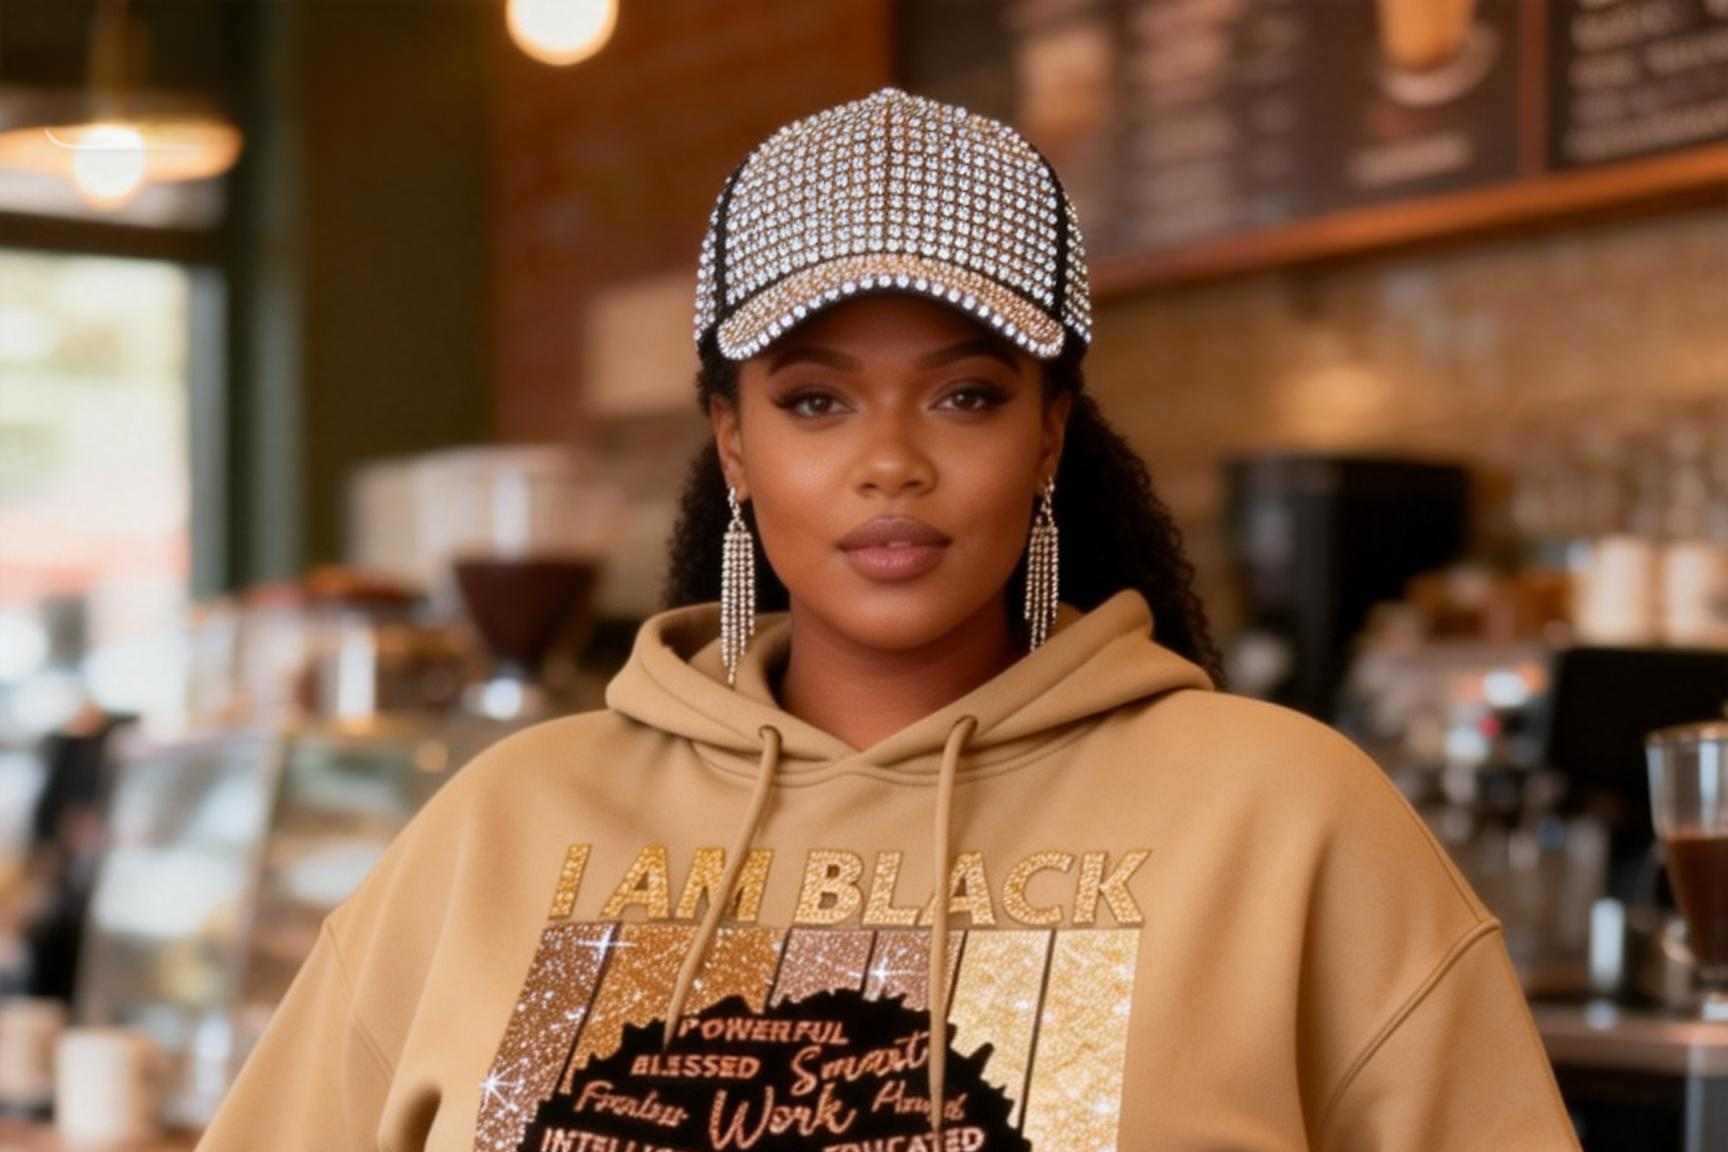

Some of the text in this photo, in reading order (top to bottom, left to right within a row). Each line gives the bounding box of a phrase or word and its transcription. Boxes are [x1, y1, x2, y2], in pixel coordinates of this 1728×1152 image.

[548, 843, 1151, 926] I AM BLACK
[678, 1017, 849, 1045] POWERFUL
[630, 1054, 761, 1079] BLESSED
